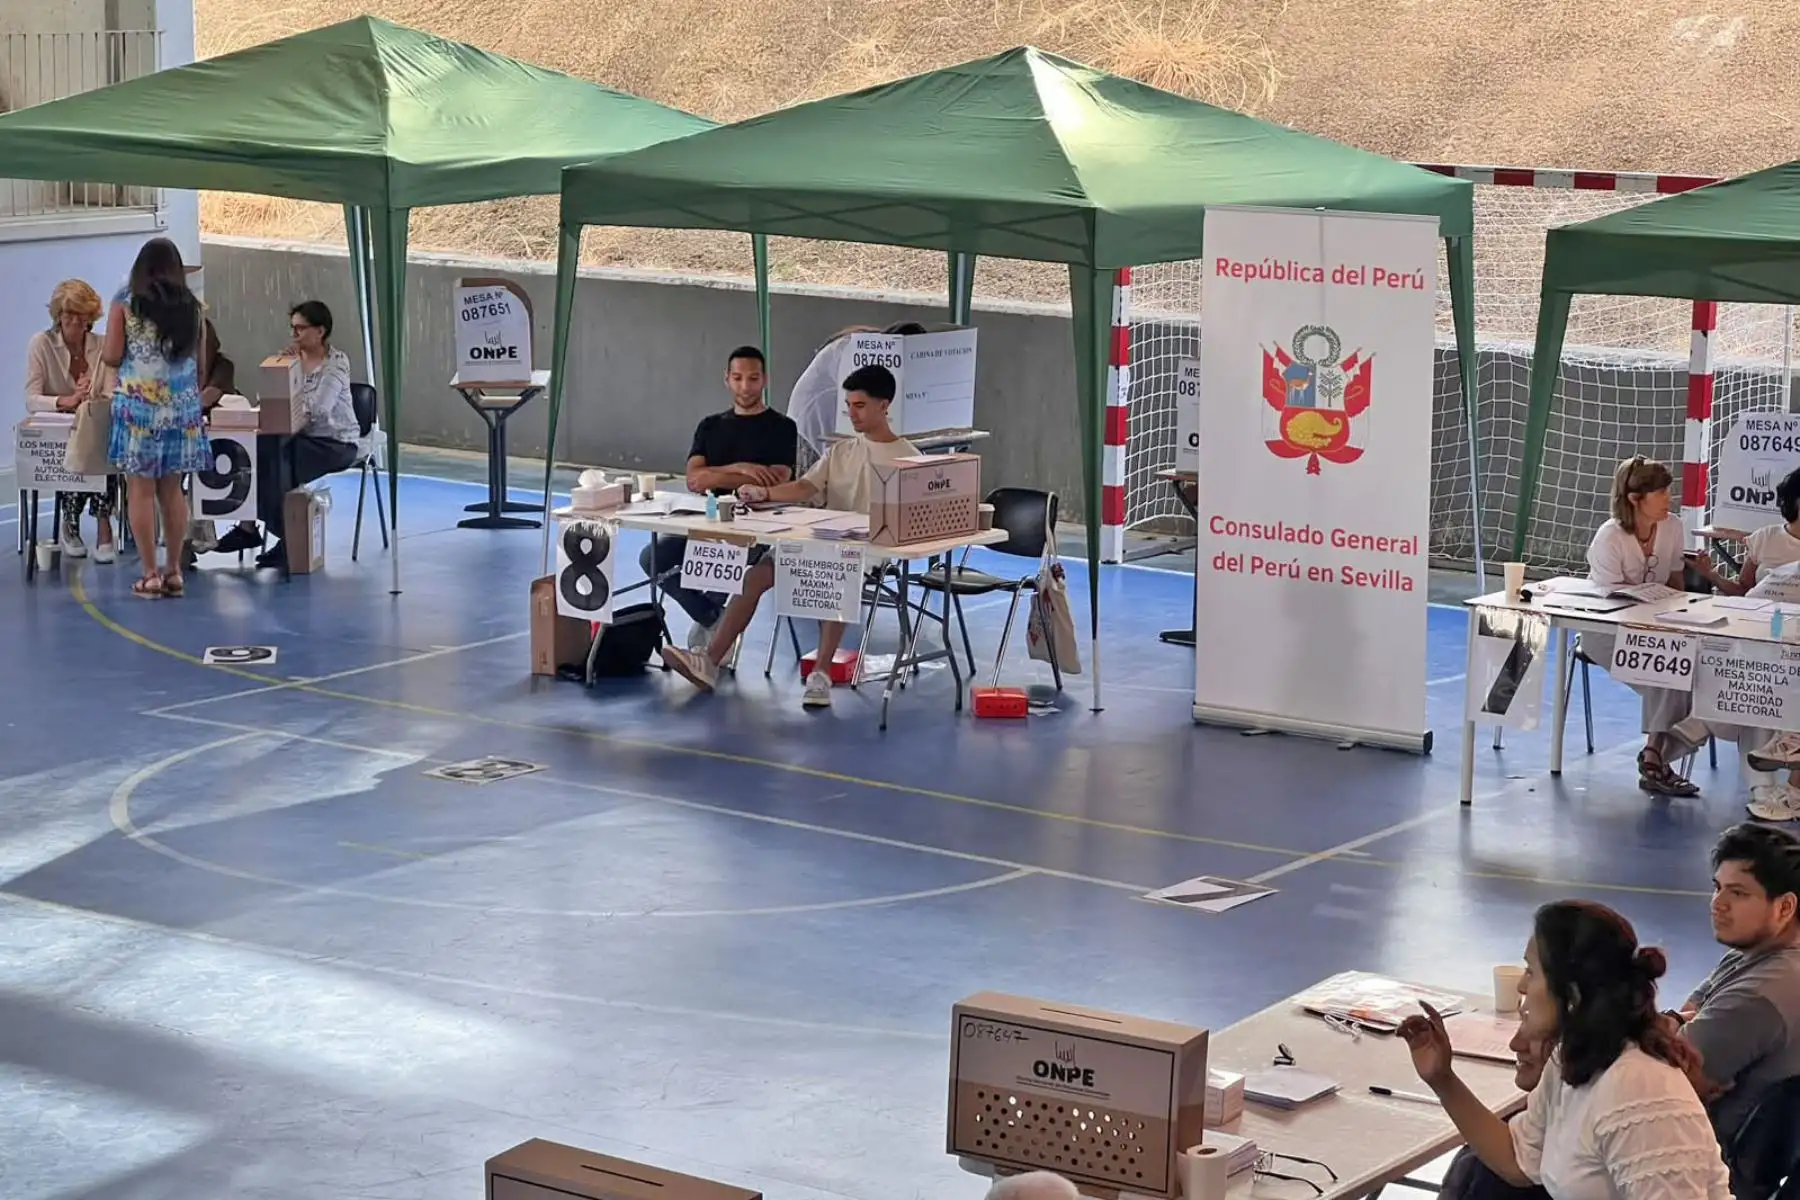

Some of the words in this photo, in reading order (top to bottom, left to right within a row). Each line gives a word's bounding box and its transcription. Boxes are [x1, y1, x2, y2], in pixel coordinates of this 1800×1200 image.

[1216, 255, 1324, 283] República
[1332, 264, 1365, 285] del
[1372, 268, 1424, 290] Perú
[464, 292, 494, 305] MESA
[461, 302, 511, 321] 087651
[469, 346, 518, 360] ONPE
[857, 340, 883, 350] MESA
[853, 353, 902, 369] 087650
[1184, 367, 1200, 378] ME
[1746, 420, 1781, 431] MESA
[20, 440, 37, 449] LOS
[1740, 434, 1800, 453] 087649
[31, 449, 55, 457] MESA
[198, 438, 251, 515] 9
[927, 478, 951, 491] ONPE
[1209, 515, 1324, 545] Consulado
[1331, 529, 1418, 555] General
[693, 546, 724, 559] MESA
[560, 522, 610, 611] 8
[685, 560, 743, 581] 087650
[780, 557, 796, 567] LOS
[798, 559, 845, 572] MIEMBROS
[846, 563, 858, 573] DE
[1212, 551, 1244, 573] del
[1251, 556, 1300, 579] Perú
[1307, 566, 1334, 583] en
[1341, 565, 1414, 592] Sevilla
[790, 568, 813, 579] MESA
[815, 570, 833, 580] SON
[835, 572, 846, 581] LA
[792, 588, 842, 601] AUTORIDAD
[792, 597, 842, 611] ELECTORAL
[1626, 633, 1666, 650] MESA
[1478, 612, 1534, 715] 7
[1615, 649, 1692, 676] 087649
[1701, 656, 1723, 667] LOS
[1726, 658, 1786, 674] MIEMBROS
[1714, 667, 1745, 681] MESA
[1748, 672, 1772, 684] SON
[1775, 675, 1789, 686] LA
[1717, 690, 1783, 707] AUTORIDAD
[1717, 700, 1783, 718] ELECTORAL
[963, 1022, 1029, 1045] 087647
[1033, 1060, 1095, 1087] ONPE
